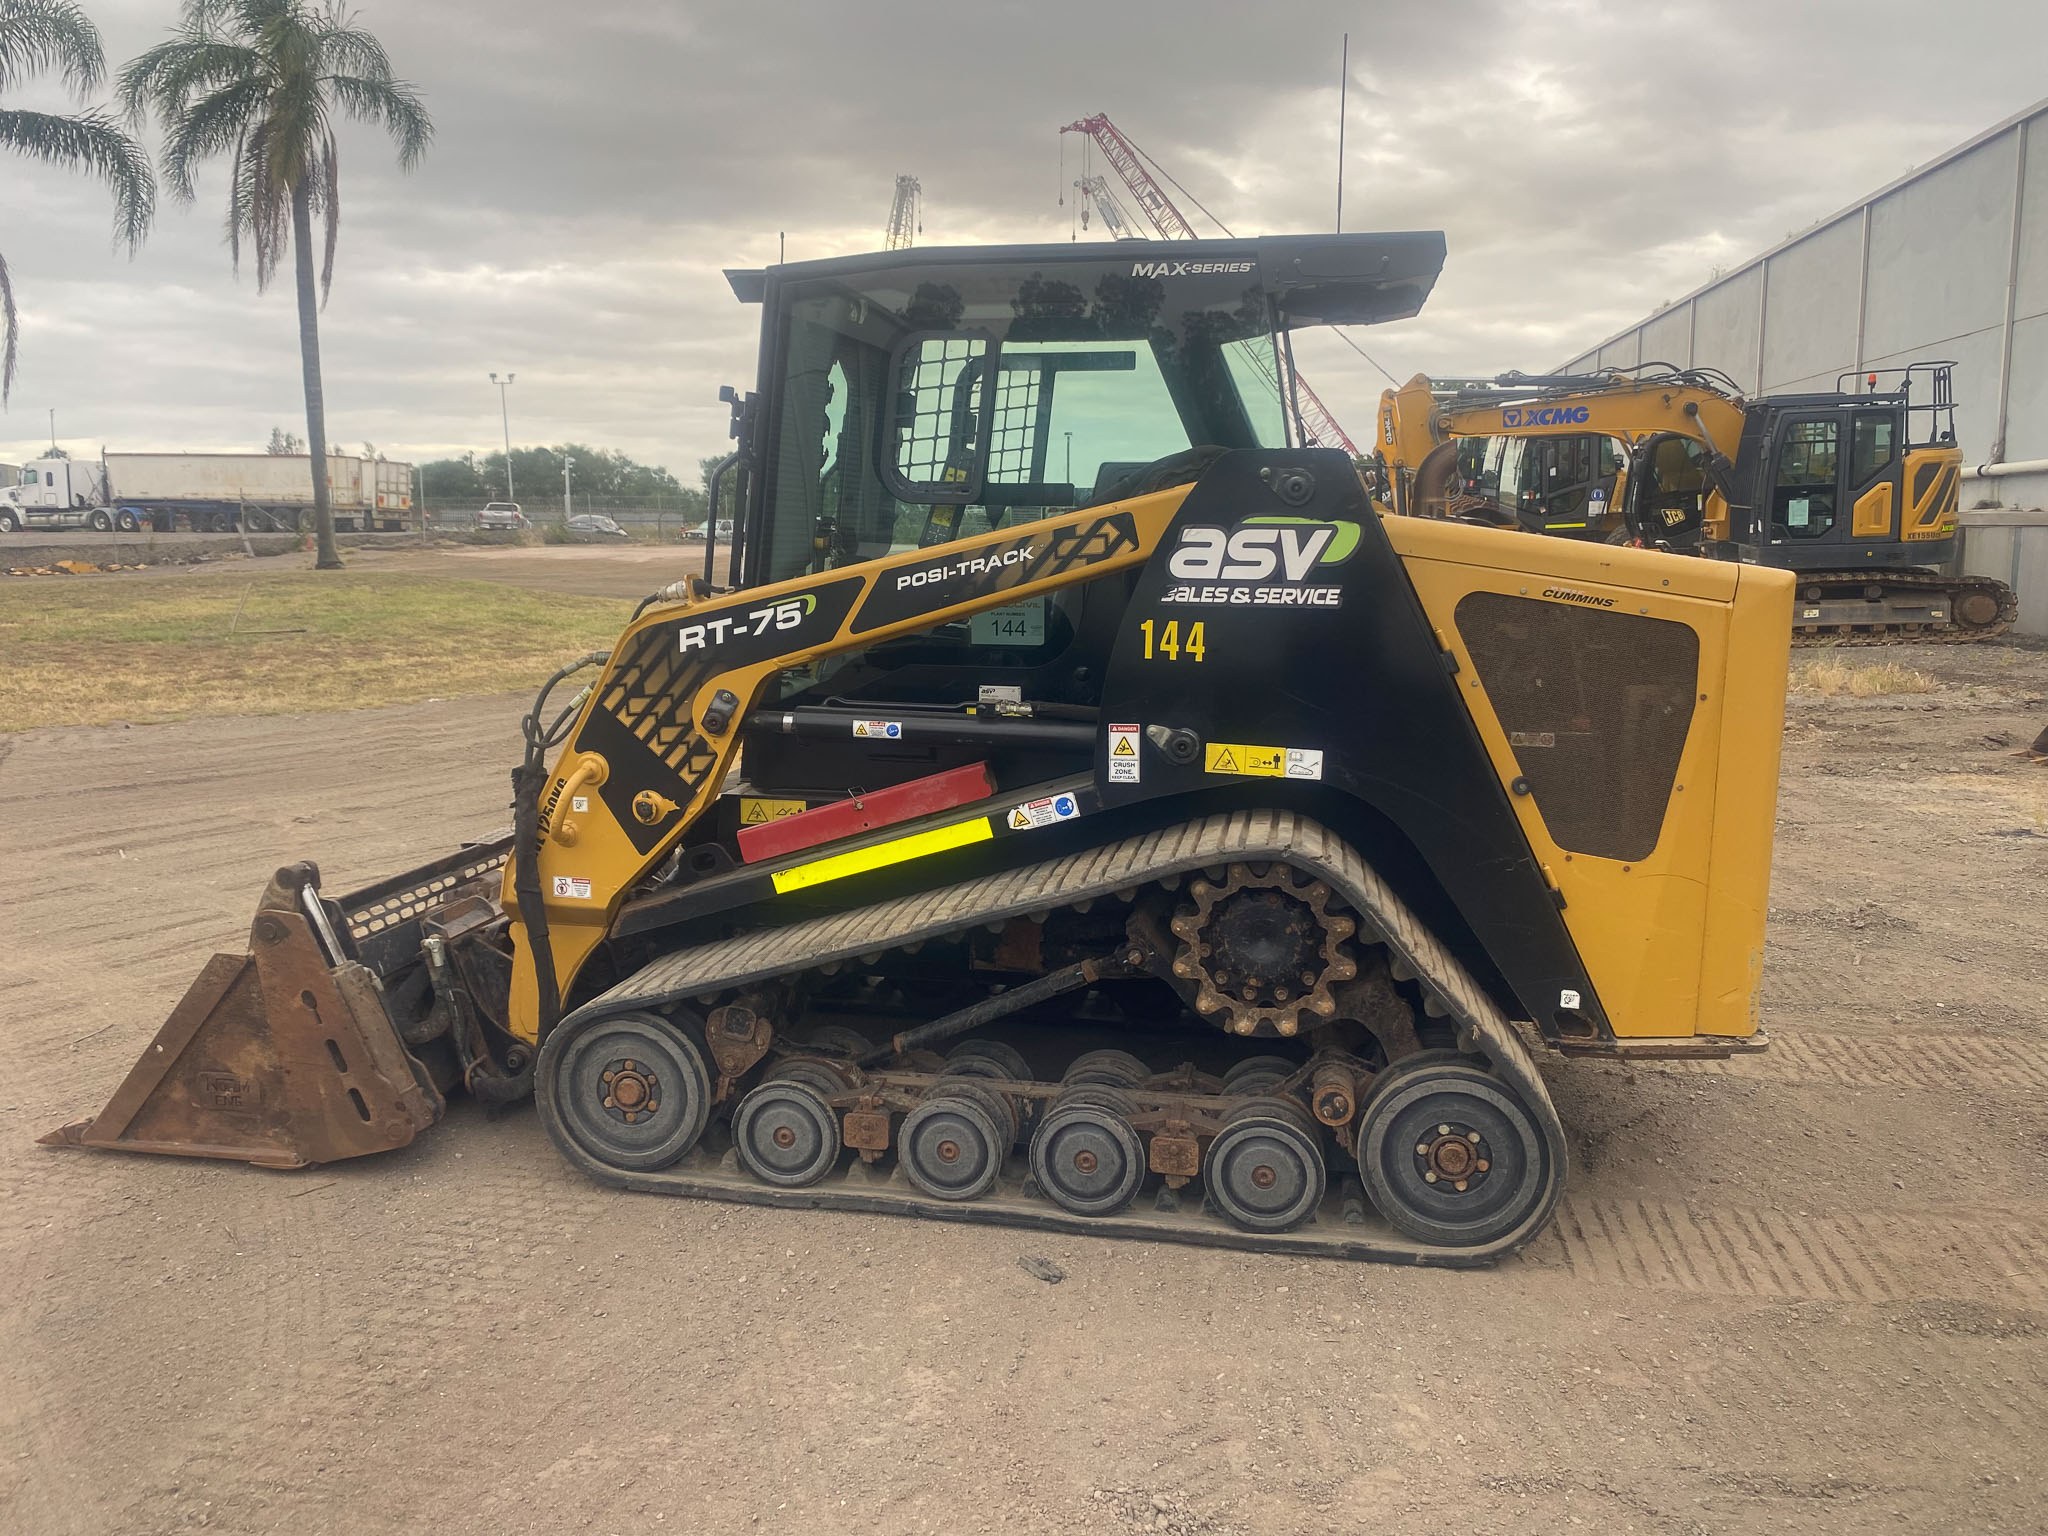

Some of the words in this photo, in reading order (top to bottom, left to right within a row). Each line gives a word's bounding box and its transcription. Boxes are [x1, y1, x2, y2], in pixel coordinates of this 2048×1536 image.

[1523, 406, 1590, 427] XCMG
[1665, 510, 1684, 524] JCB
[896, 546, 1034, 591] POSI-TRACK
[1230, 588, 1251, 603] &
[1253, 588, 1341, 605] SERVICE
[1542, 589, 1615, 607] CUMMINS
[679, 601, 802, 653] RT-75
[992, 619, 1026, 637] 144
[1140, 619, 1206, 662] 144
